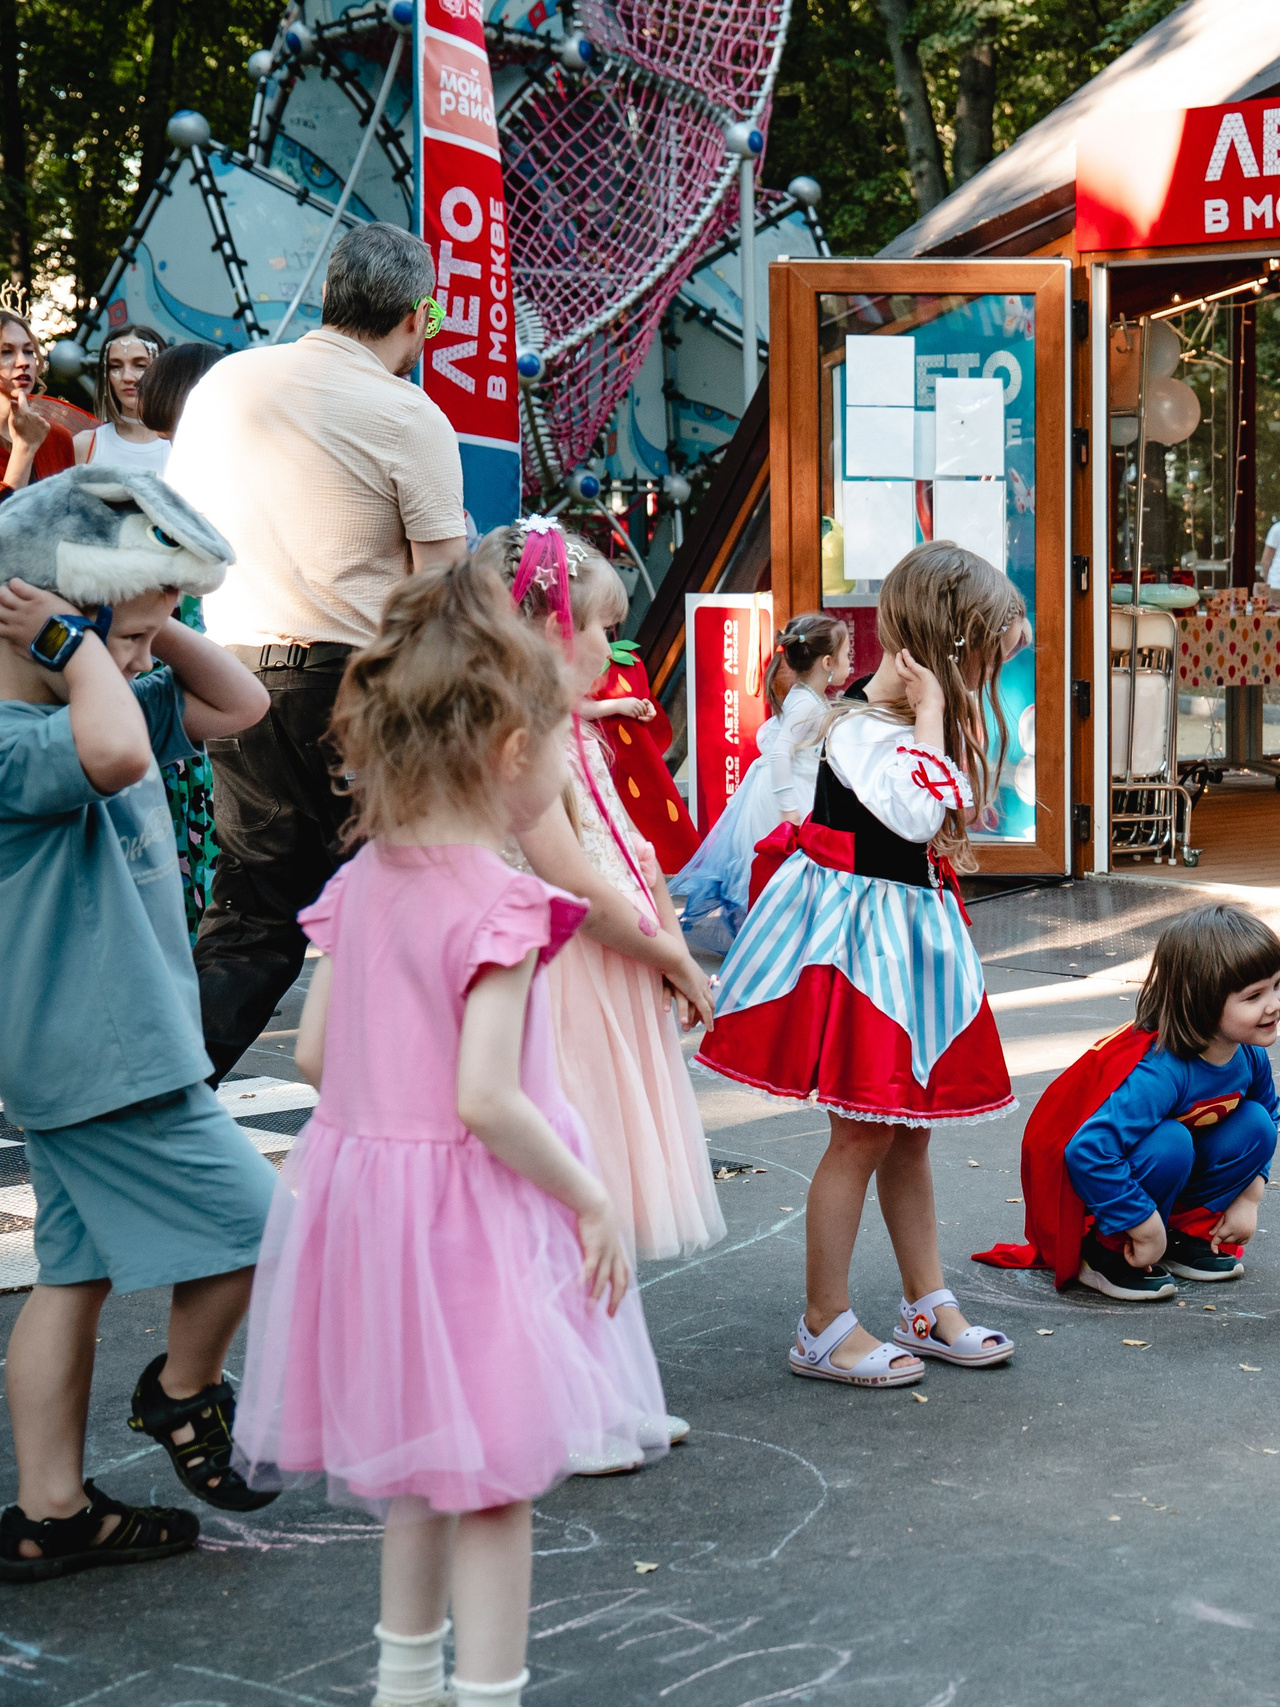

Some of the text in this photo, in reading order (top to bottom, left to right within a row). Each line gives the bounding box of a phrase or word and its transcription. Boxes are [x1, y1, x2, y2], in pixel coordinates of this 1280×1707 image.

[1204, 198, 1230, 234] В
[432, 186, 484, 395] ЛЕТО
[487, 196, 508, 402] В МОСКВЕ
[915, 350, 1023, 407] ЕТО
[724, 619, 733, 675] ЛЕТО
[724, 689, 734, 744] ЛЕТО
